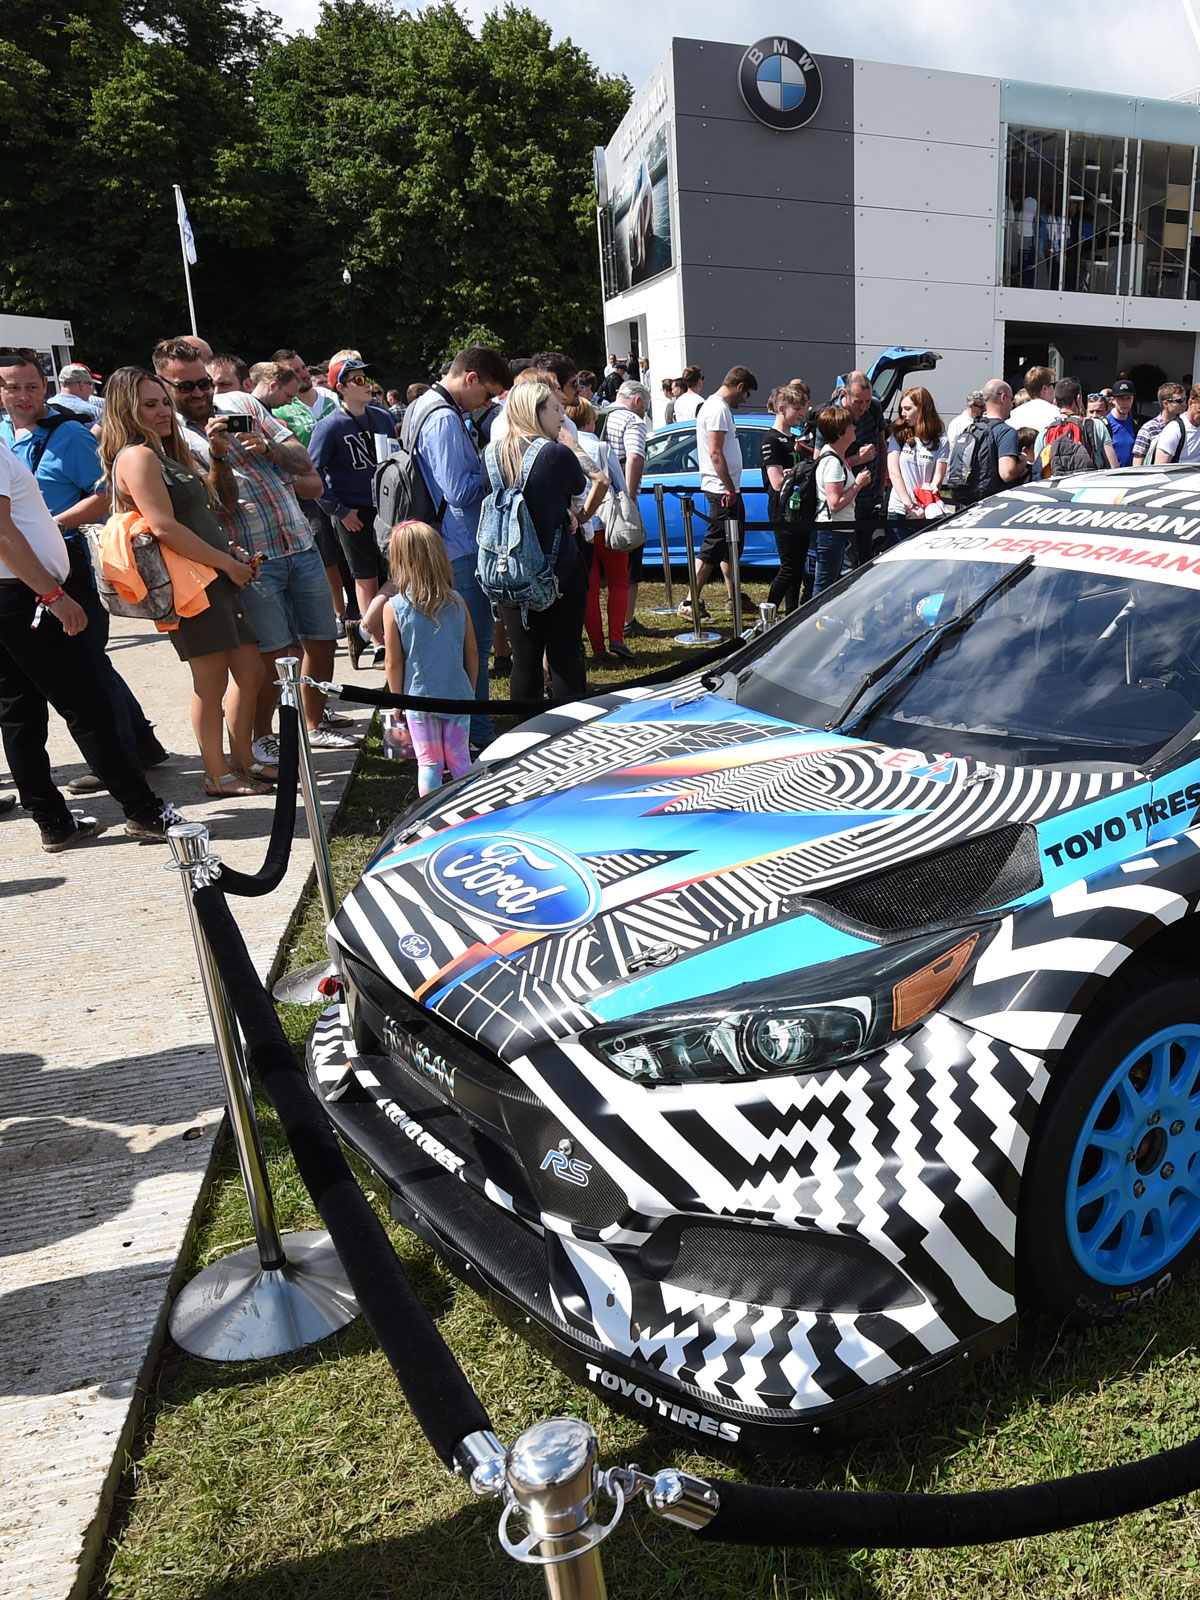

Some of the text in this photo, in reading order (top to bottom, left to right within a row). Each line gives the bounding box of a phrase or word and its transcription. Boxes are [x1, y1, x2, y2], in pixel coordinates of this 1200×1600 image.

[748, 39, 815, 72] BMW
[344, 430, 377, 470] N
[918, 537, 990, 550] FORD
[1044, 816, 1127, 868] TOYO
[442, 841, 568, 916] Ford
[402, 935, 426, 957] Ford
[385, 1102, 466, 1174] TOYO TIRES
[540, 1149, 592, 1187] RS
[585, 1362, 742, 1444] TOYO TIRES
